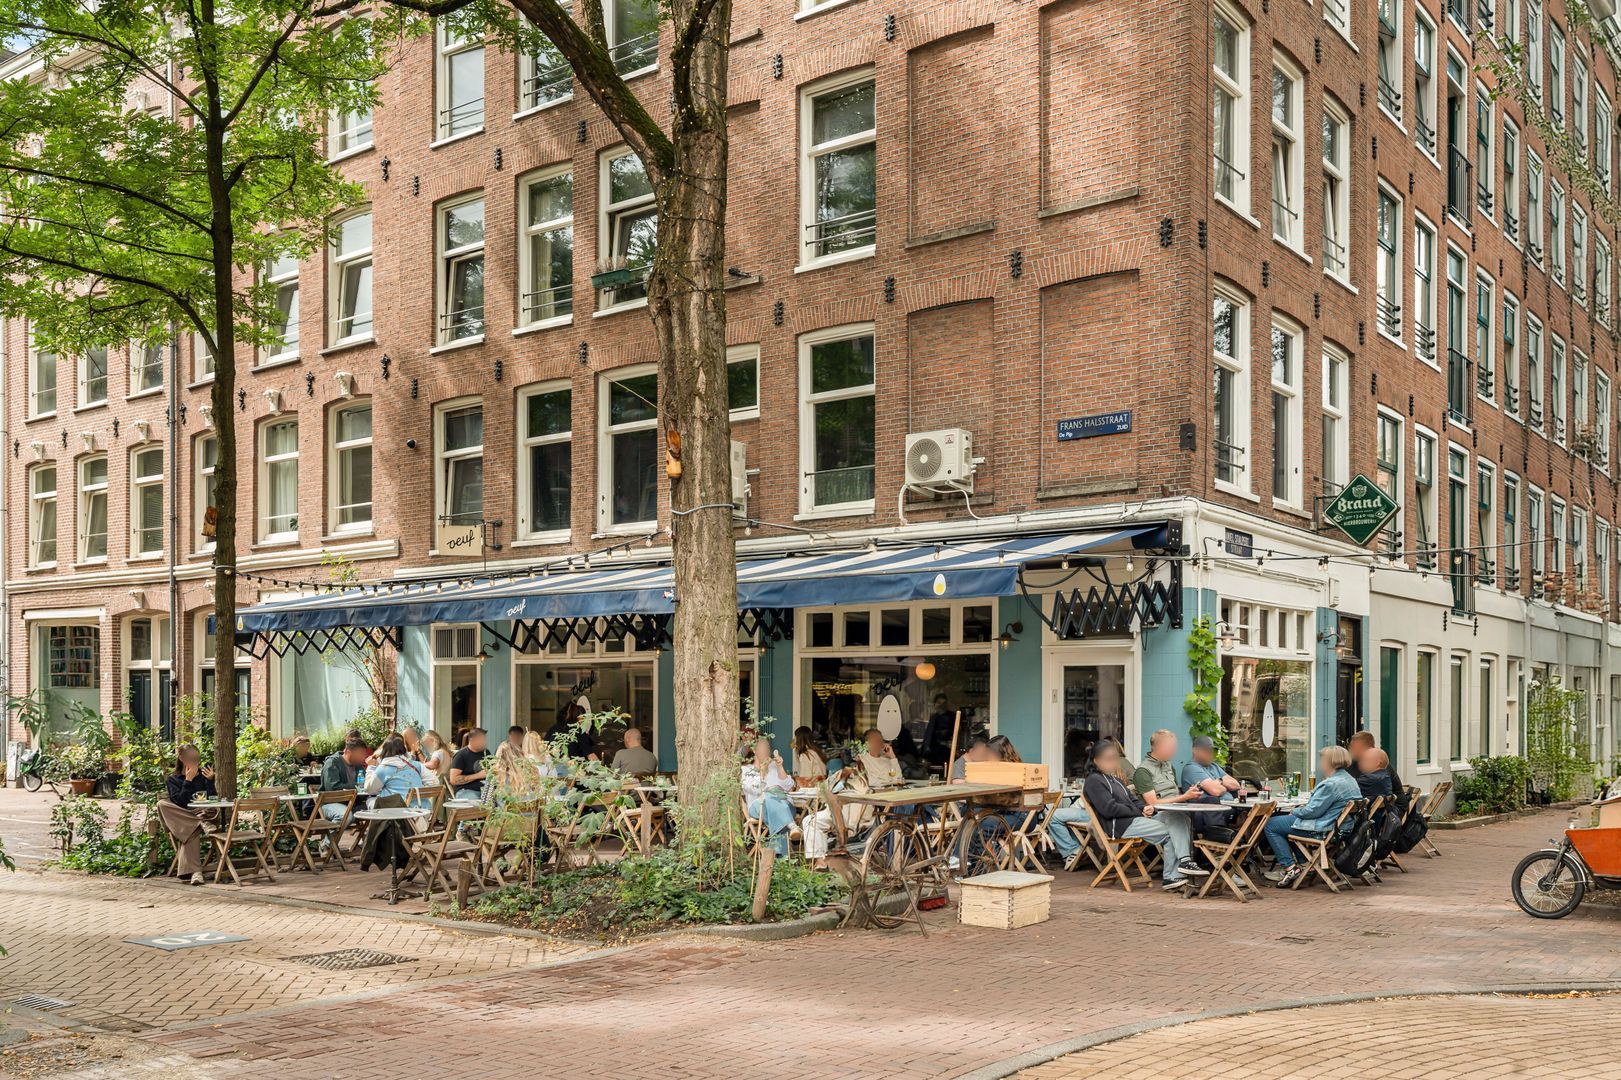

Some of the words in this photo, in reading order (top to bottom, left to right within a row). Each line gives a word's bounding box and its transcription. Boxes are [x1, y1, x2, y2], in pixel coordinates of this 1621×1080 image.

[1060, 420, 1083, 431] FRANS
[1084, 413, 1128, 427] HALSSTRAAT
[1337, 495, 1382, 512] Brand
